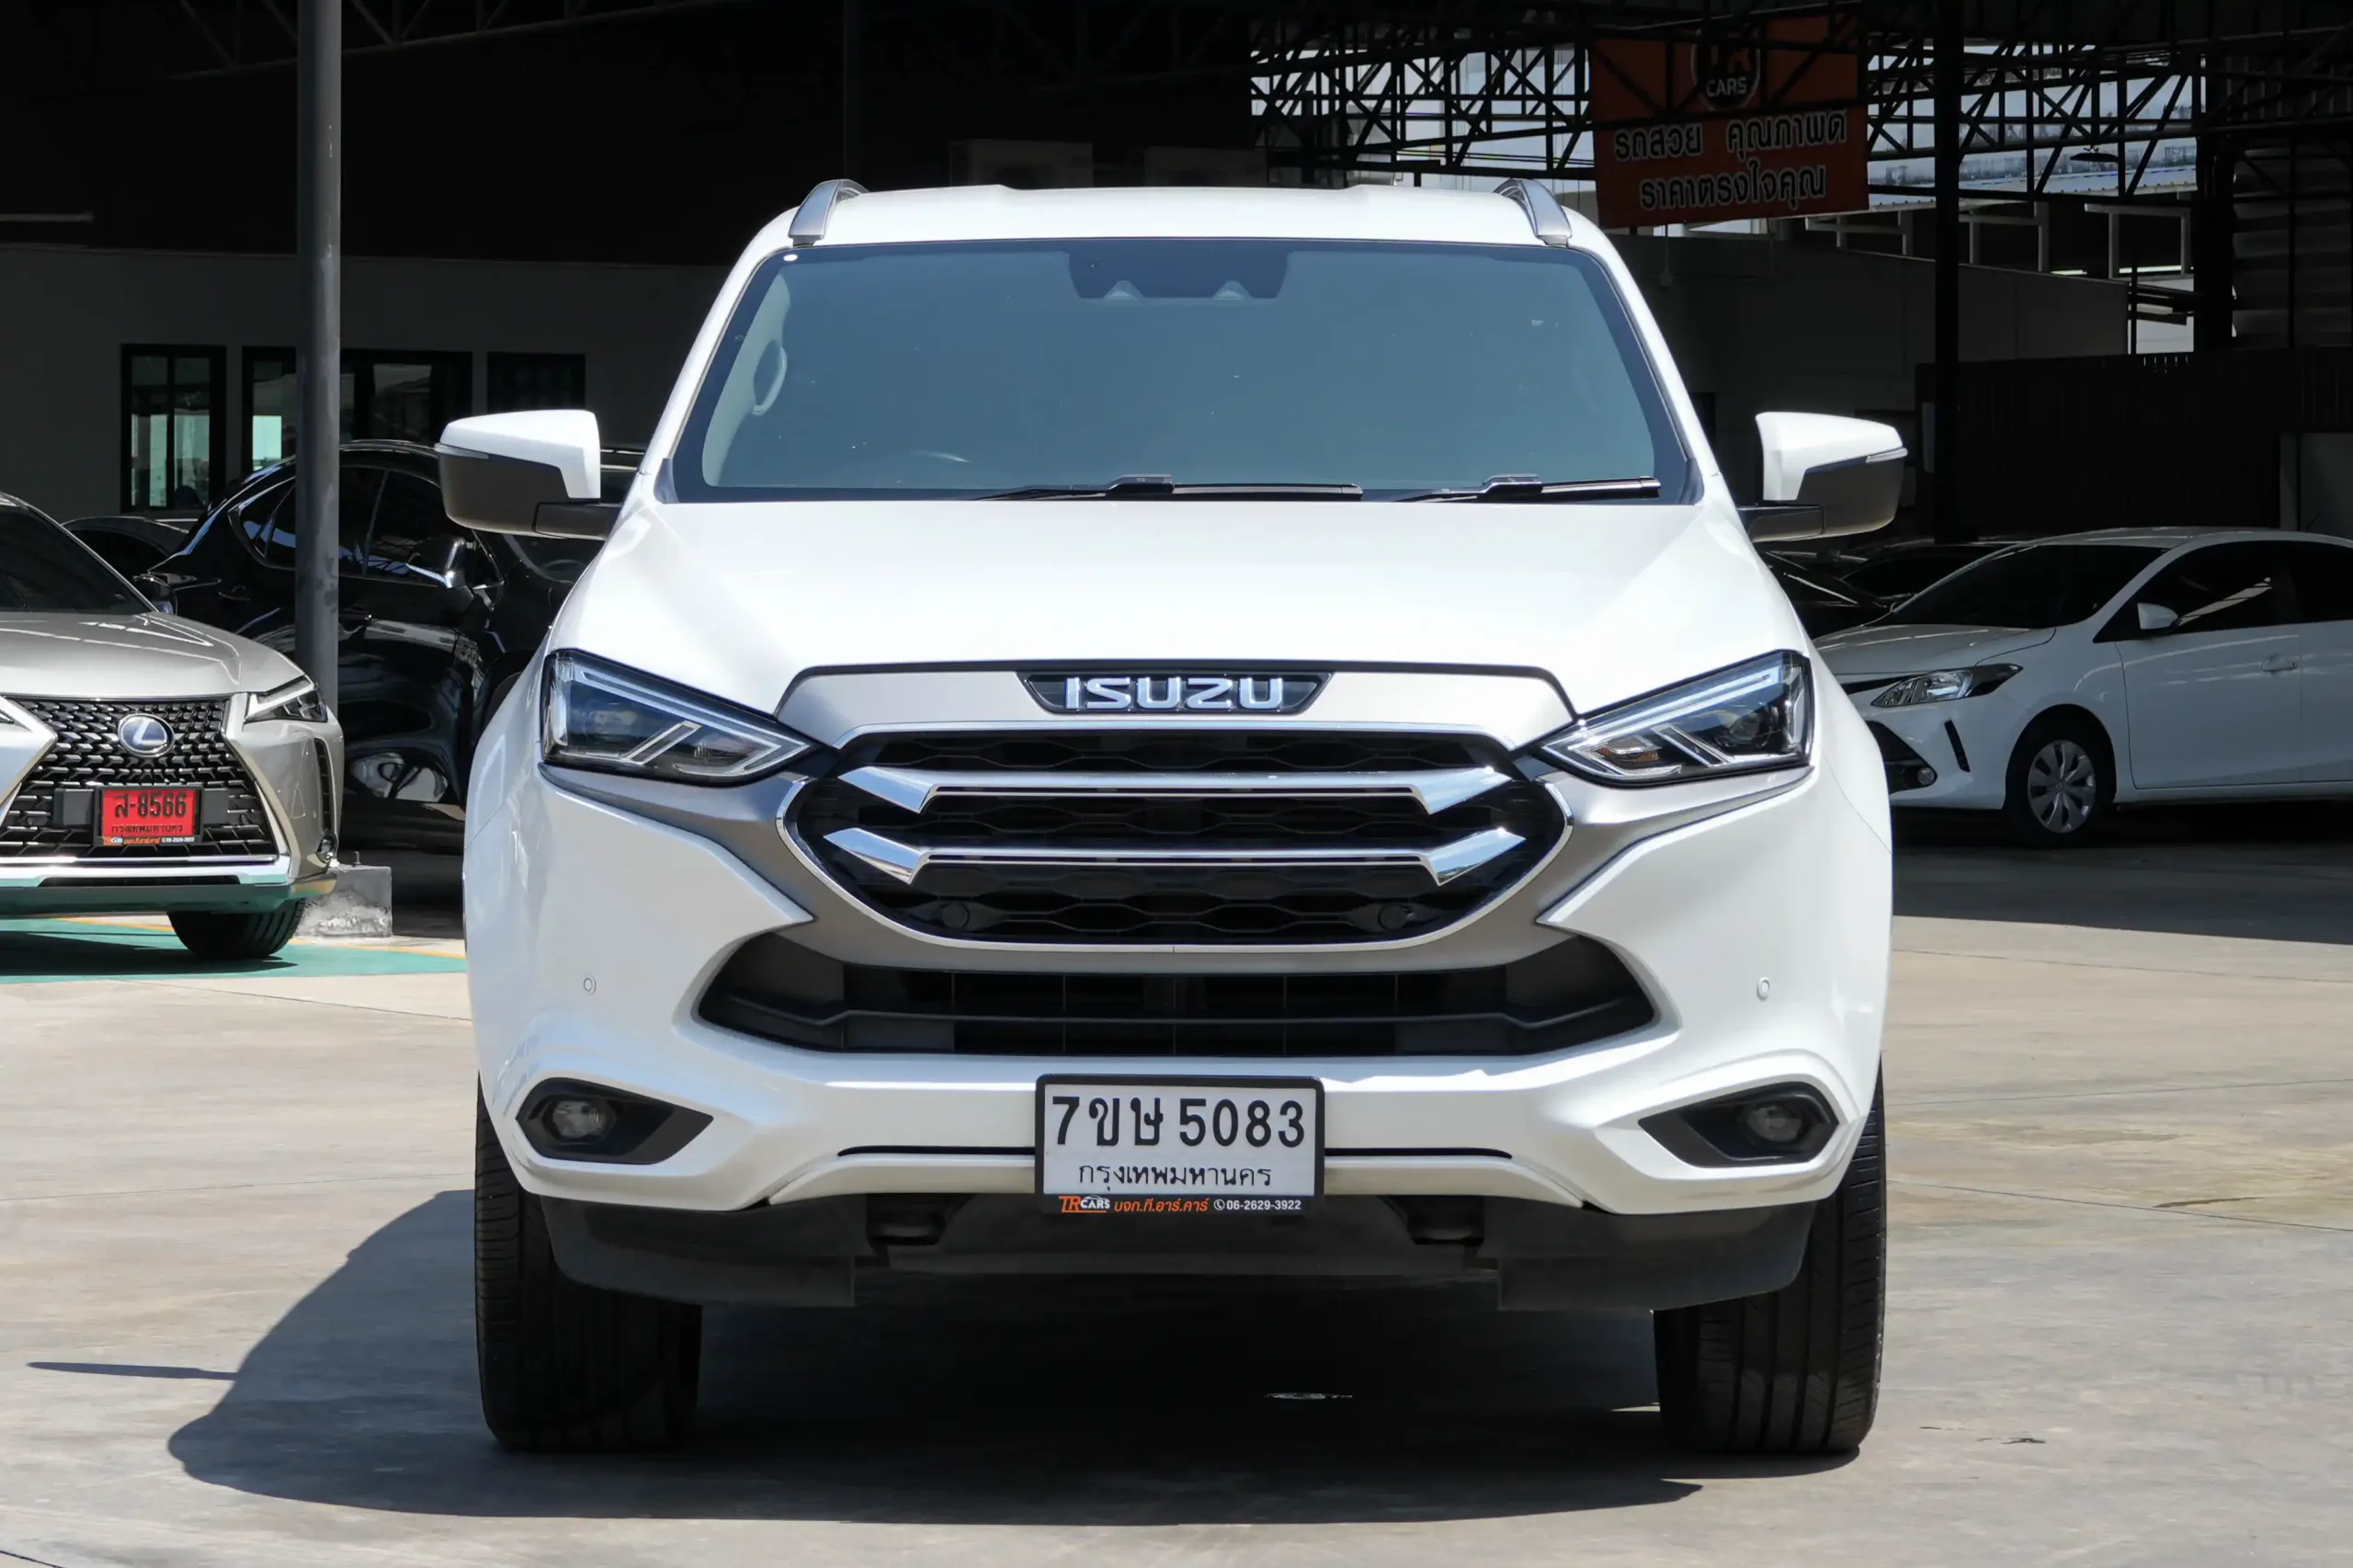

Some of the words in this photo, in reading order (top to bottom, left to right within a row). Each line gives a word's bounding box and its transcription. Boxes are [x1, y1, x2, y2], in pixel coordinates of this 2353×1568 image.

[1706, 75, 1748, 98] CARS
[1614, 123, 1702, 162] รถสวย
[1726, 109, 1847, 161] คุณภาพด
[1641, 157, 1826, 211] ราคาตรงใจคุณ
[1065, 676, 1283, 710] ISUZU
[1052, 1096, 1164, 1146] 7ขษ
[1179, 1098, 1305, 1148] 5083
[1079, 1164, 1271, 1191] กรุงเทพมหานคร
[1226, 1199, 1302, 1210] 06-2629-3922
